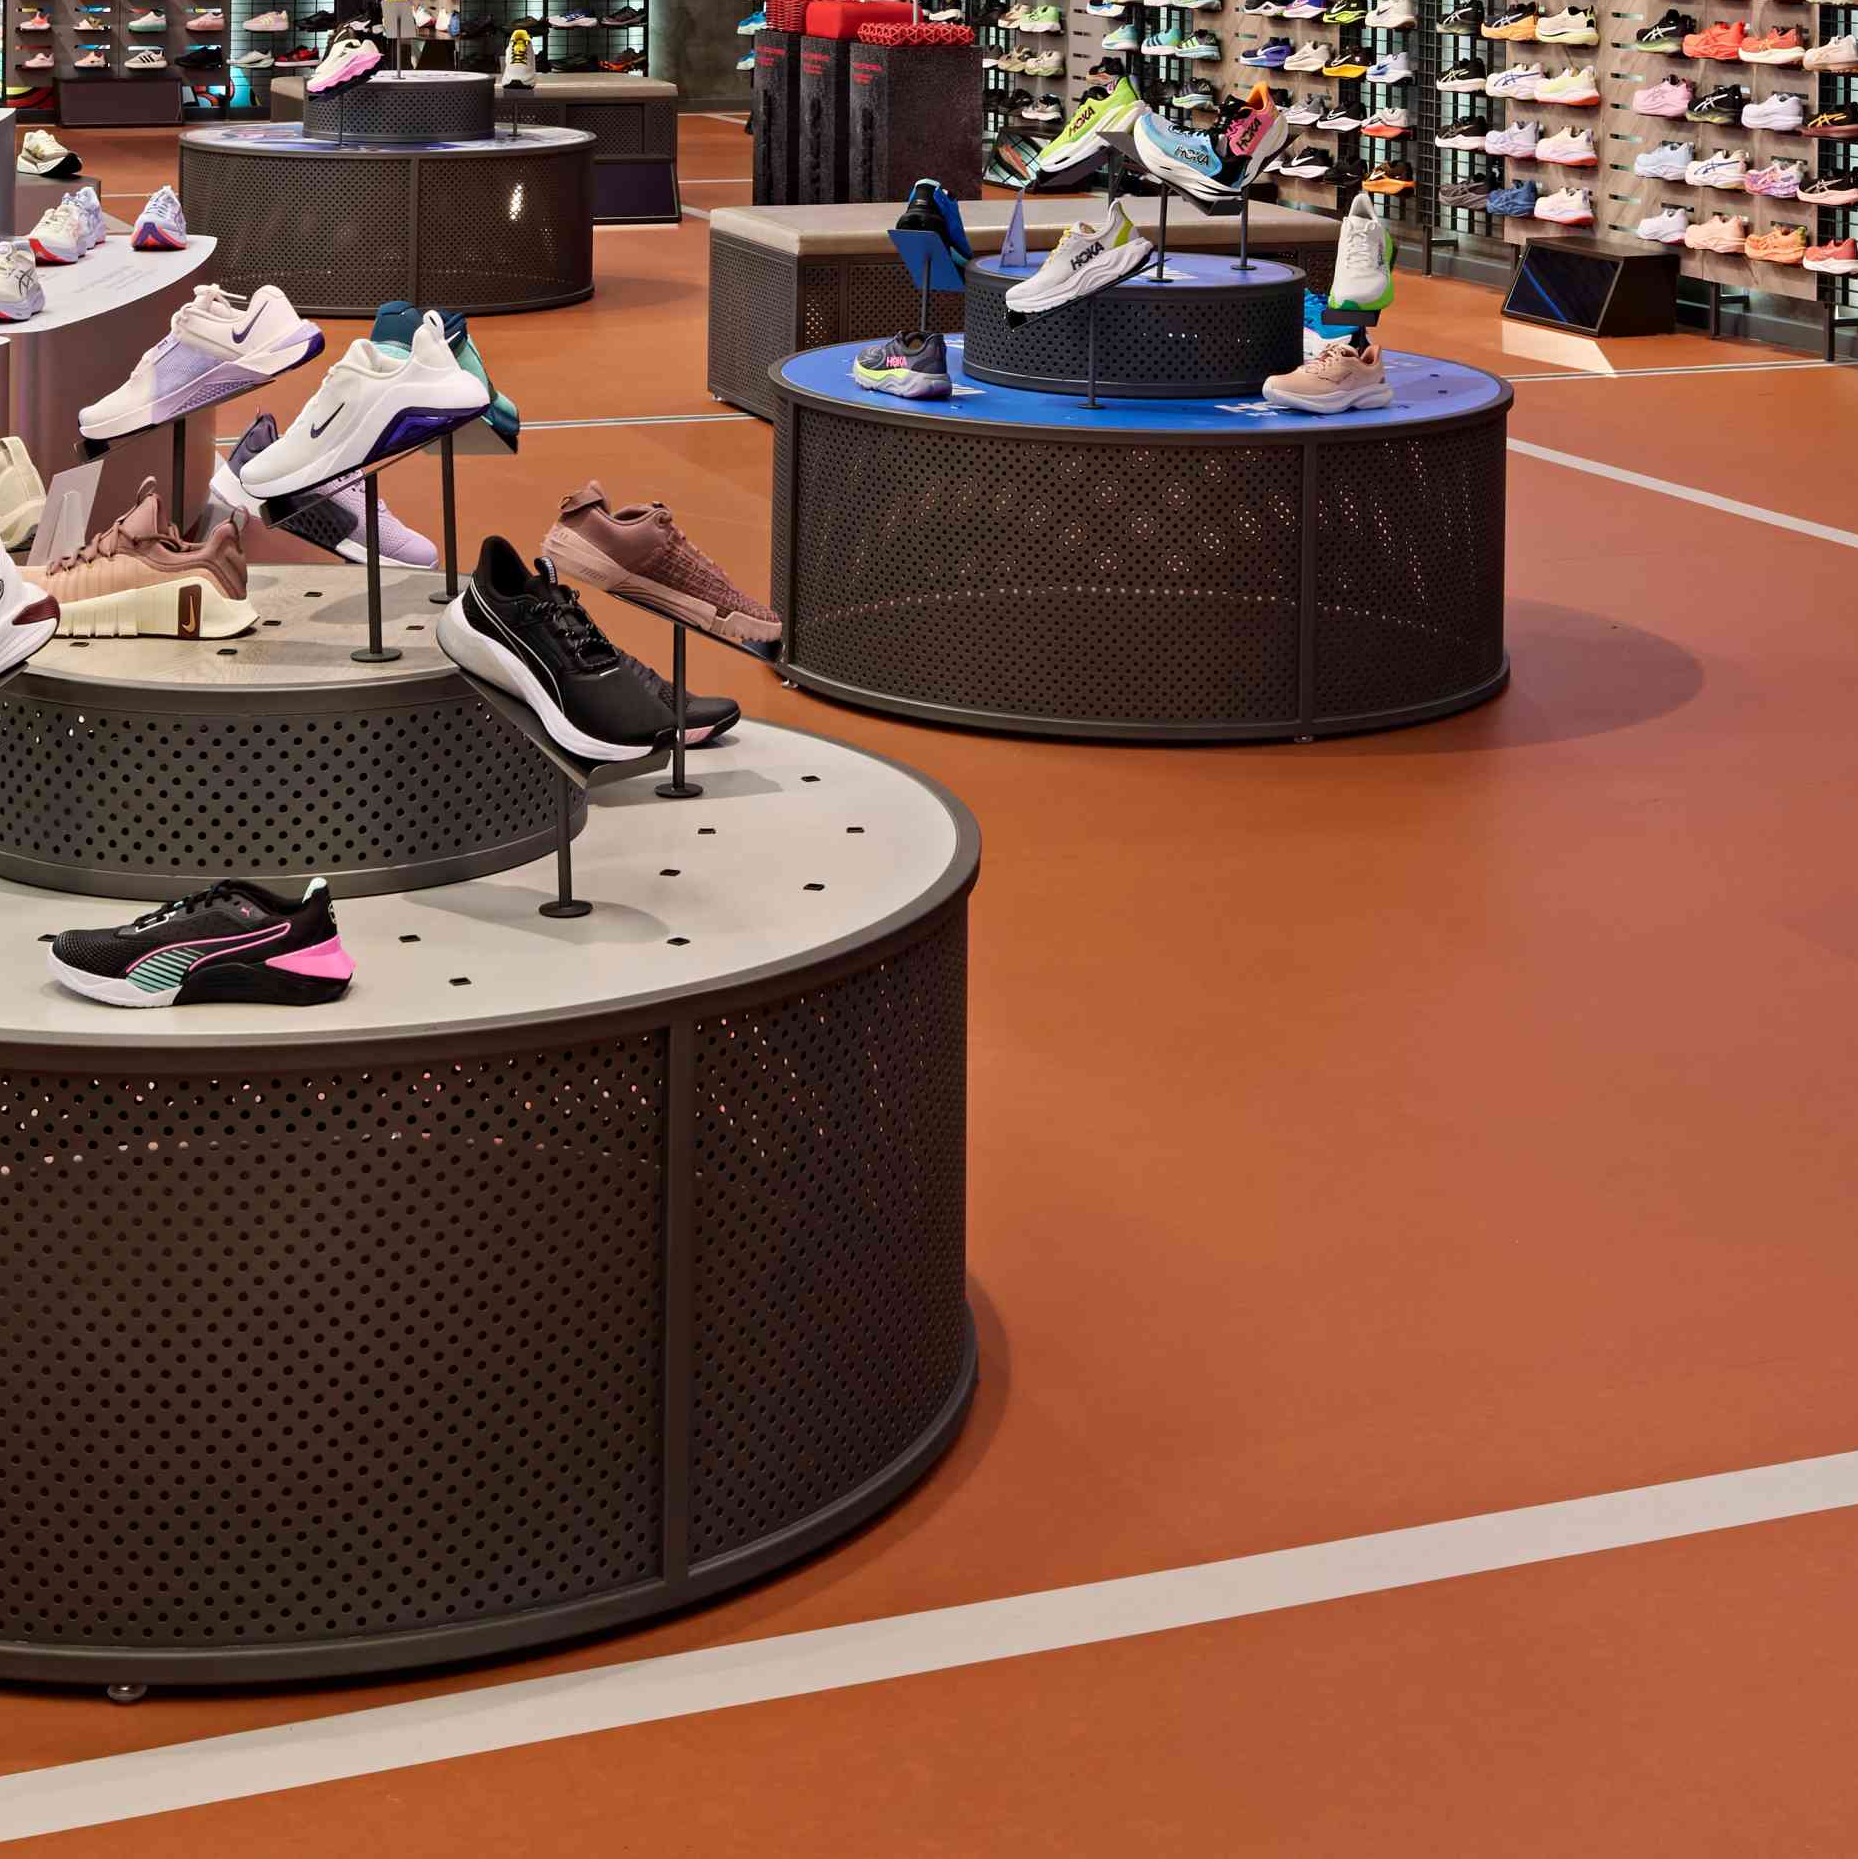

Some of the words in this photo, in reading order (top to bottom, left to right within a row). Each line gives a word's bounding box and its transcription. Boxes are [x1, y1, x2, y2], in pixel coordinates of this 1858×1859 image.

[1069, 106, 1095, 137] HOKA
[1237, 117, 1263, 150] HOKA
[1070, 241, 1105, 270] HOKA
[886, 356, 907, 367] HOKA
